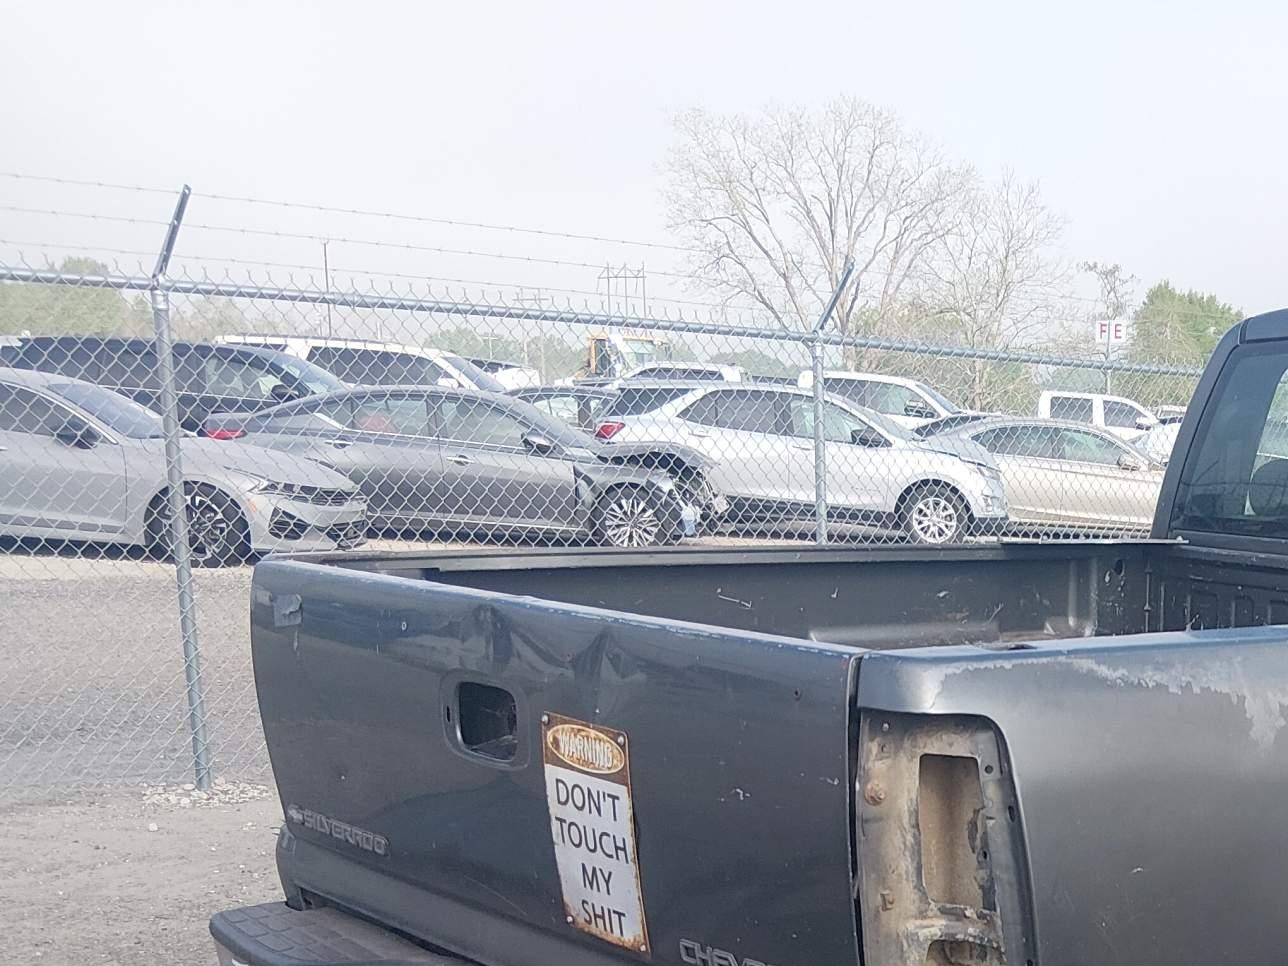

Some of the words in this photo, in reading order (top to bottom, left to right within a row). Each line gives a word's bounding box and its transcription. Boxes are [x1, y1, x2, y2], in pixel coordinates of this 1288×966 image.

[558, 732, 615, 768] WARNING
[555, 778, 620, 822] DON'T
[304, 808, 389, 856] SILVERADO
[554, 816, 630, 864] TOUCH
[581, 862, 613, 896] MY
[581, 898, 626, 937] SHIT
